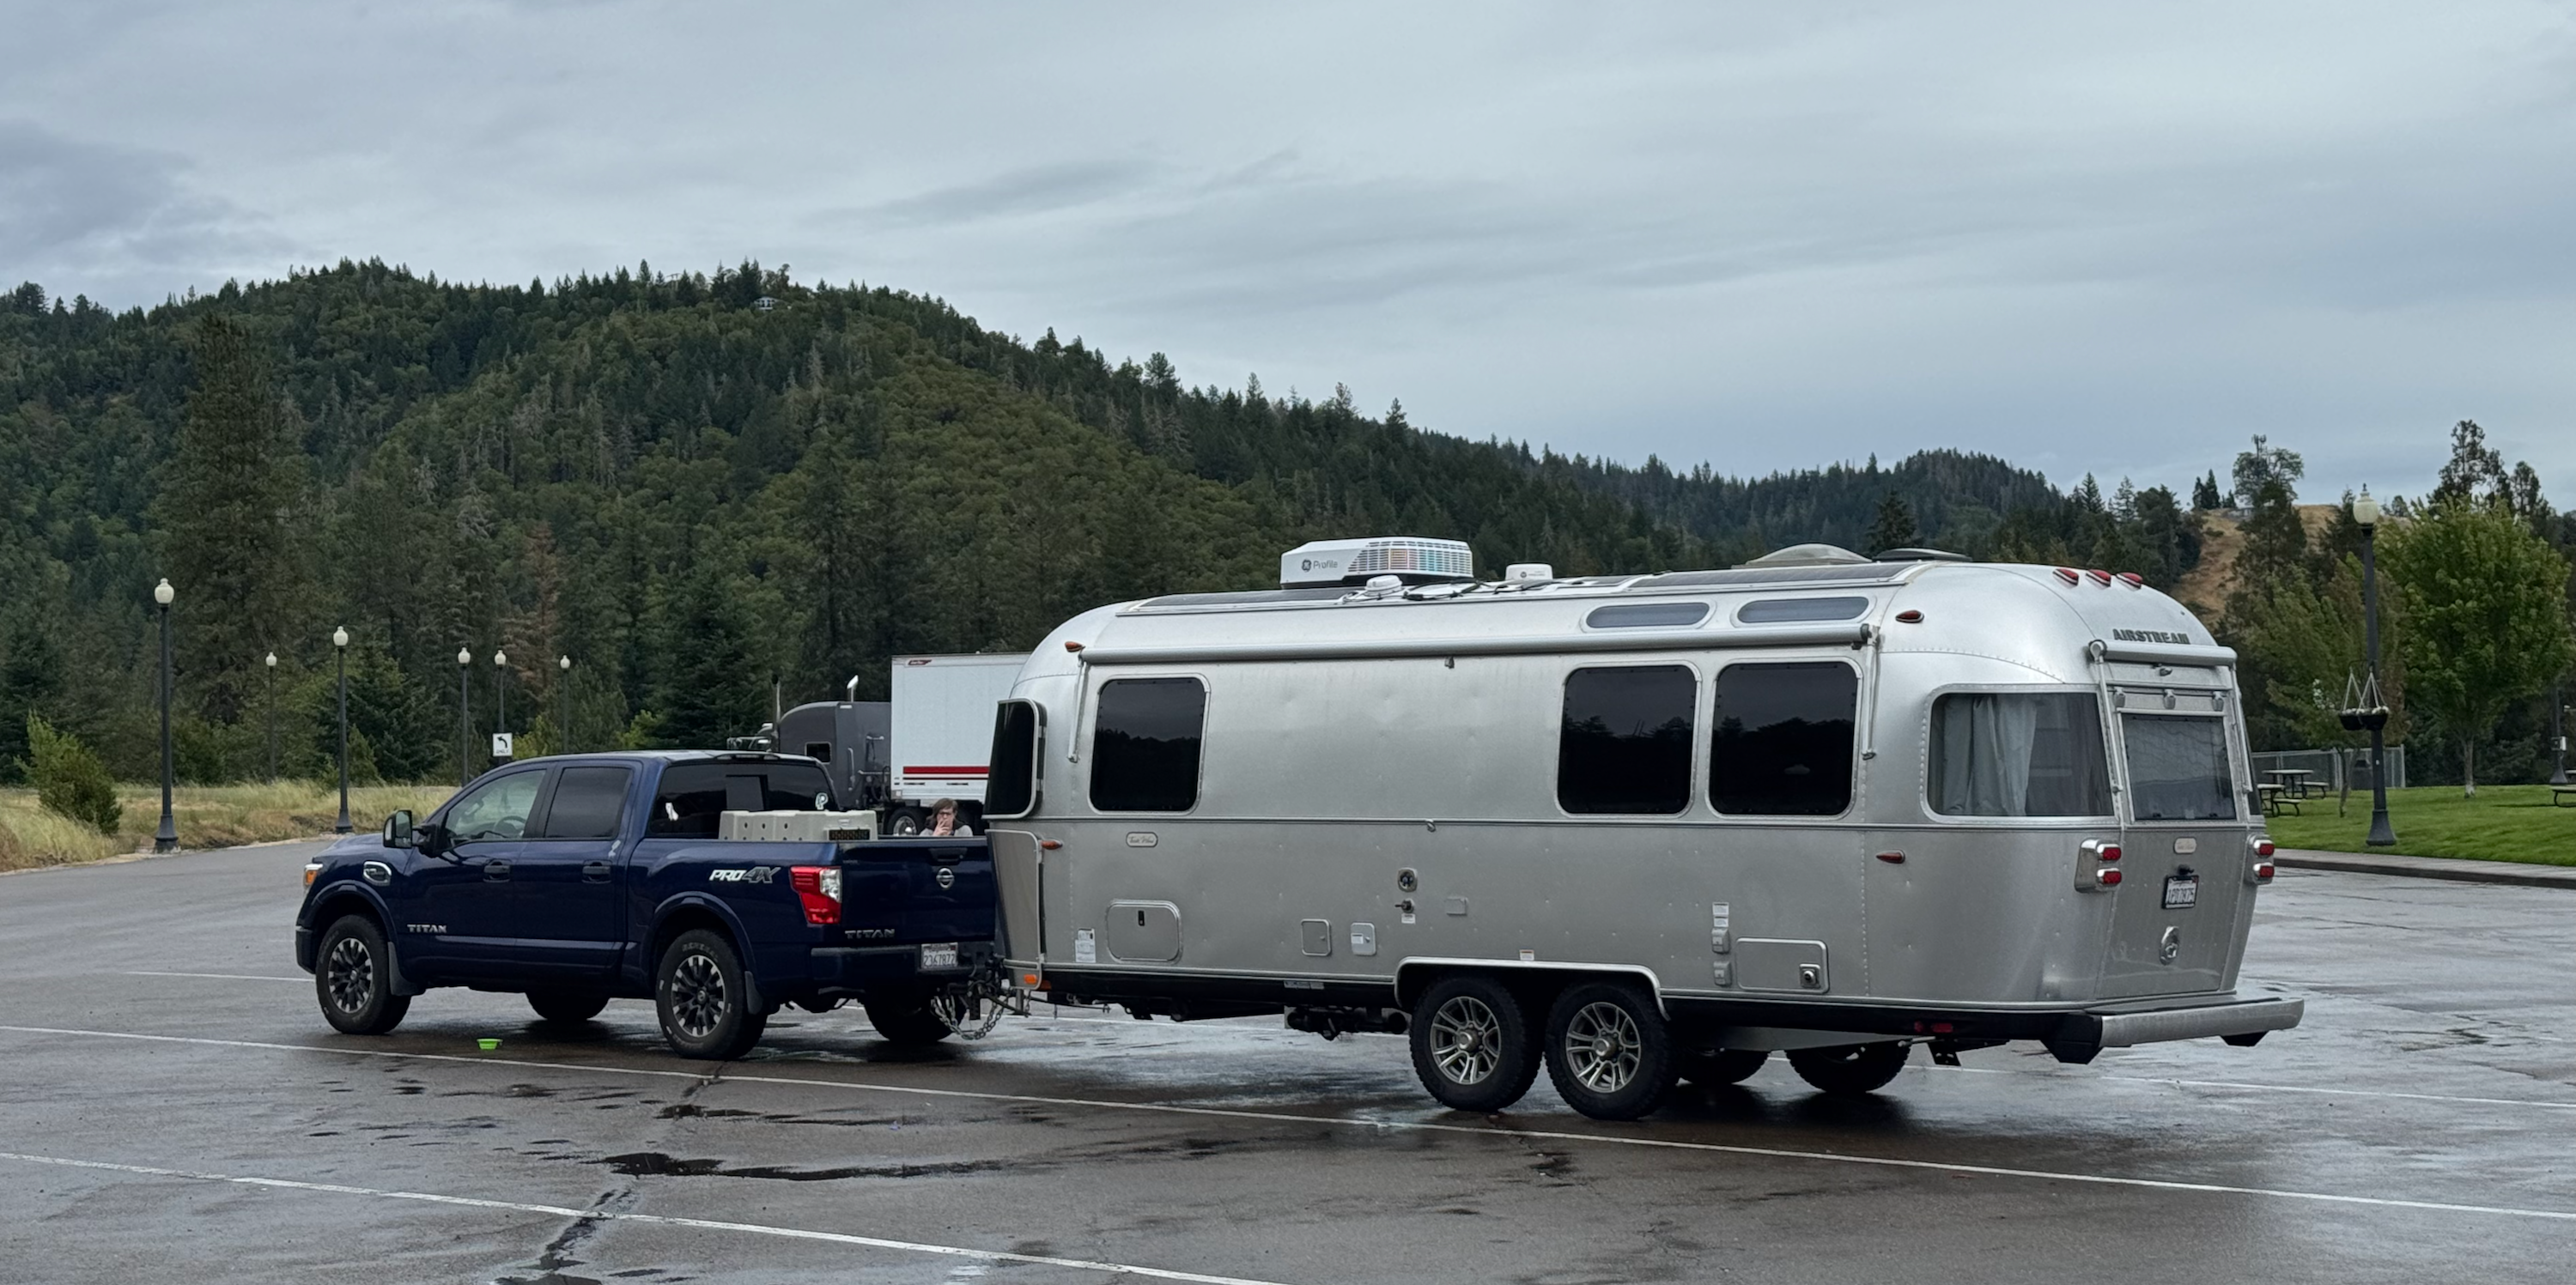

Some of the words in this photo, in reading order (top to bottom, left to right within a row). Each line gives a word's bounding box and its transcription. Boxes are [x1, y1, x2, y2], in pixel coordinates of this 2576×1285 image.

[1313, 560, 1338, 569] Profile
[2112, 628, 2191, 645] AIRSTREAM
[406, 924, 447, 934] TITAN
[844, 929, 895, 939] TITAN
